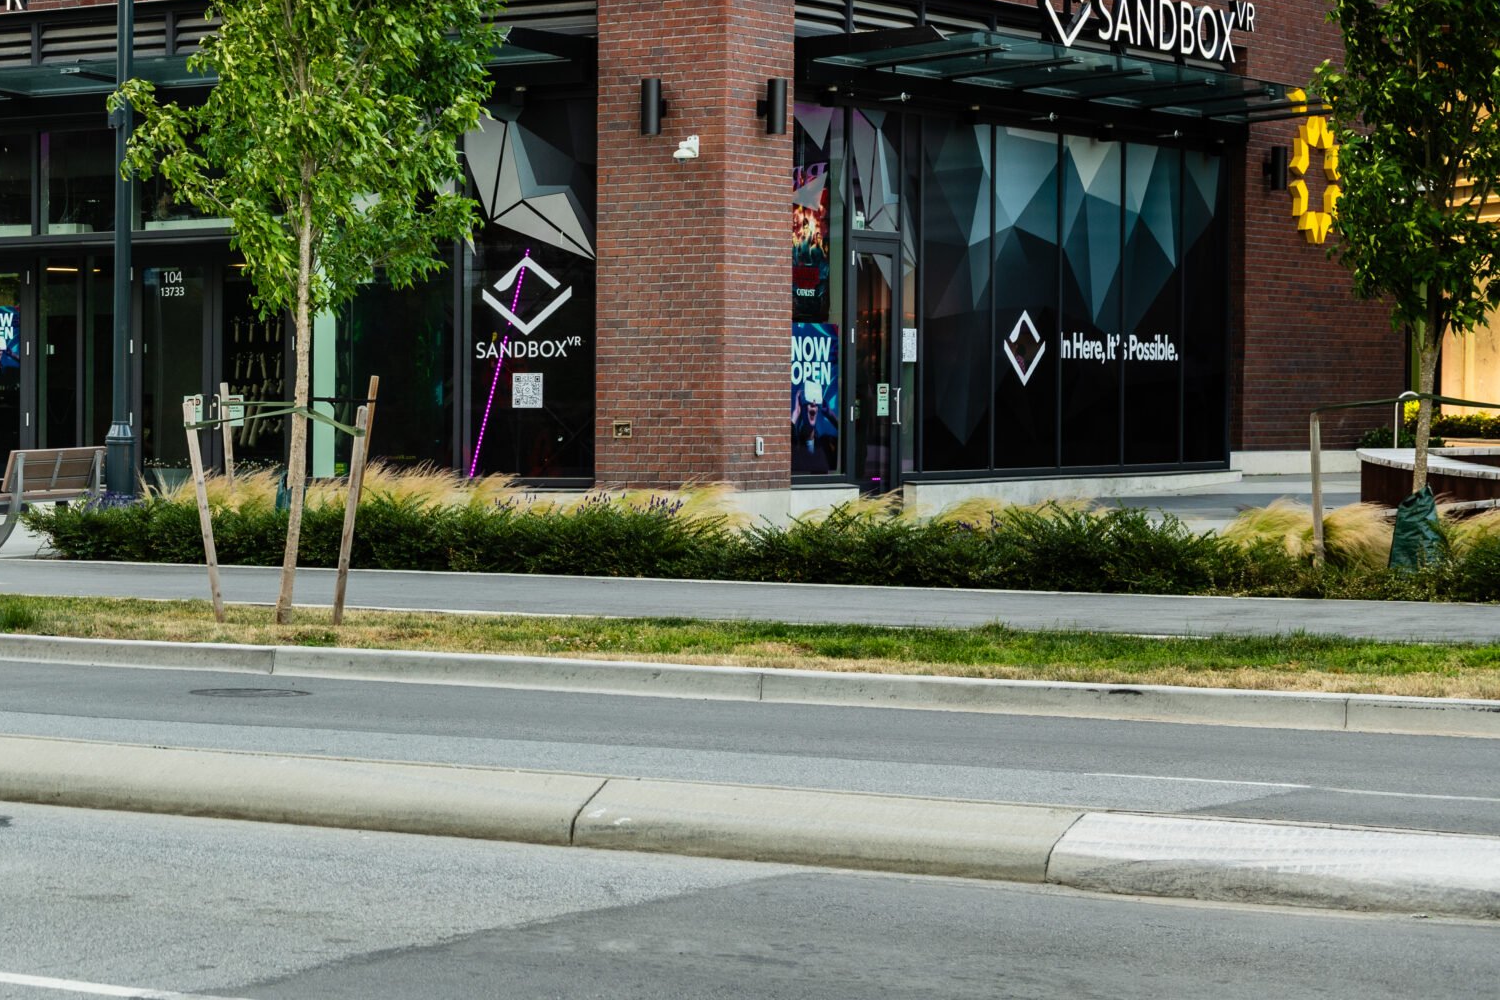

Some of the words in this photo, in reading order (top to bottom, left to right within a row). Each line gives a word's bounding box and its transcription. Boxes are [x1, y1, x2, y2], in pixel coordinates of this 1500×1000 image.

[1236, 0, 1255, 32] VR
[163, 271, 183, 284] 104
[160, 287, 185, 297] 13733
[475, 340, 568, 359] SANDBOX
[791, 335, 832, 362] NOW
[1060, 331, 1071, 359] In
[1073, 332, 1105, 365] Here,
[1129, 334, 1179, 361] Possible.
[791, 361, 832, 385] OPEN
